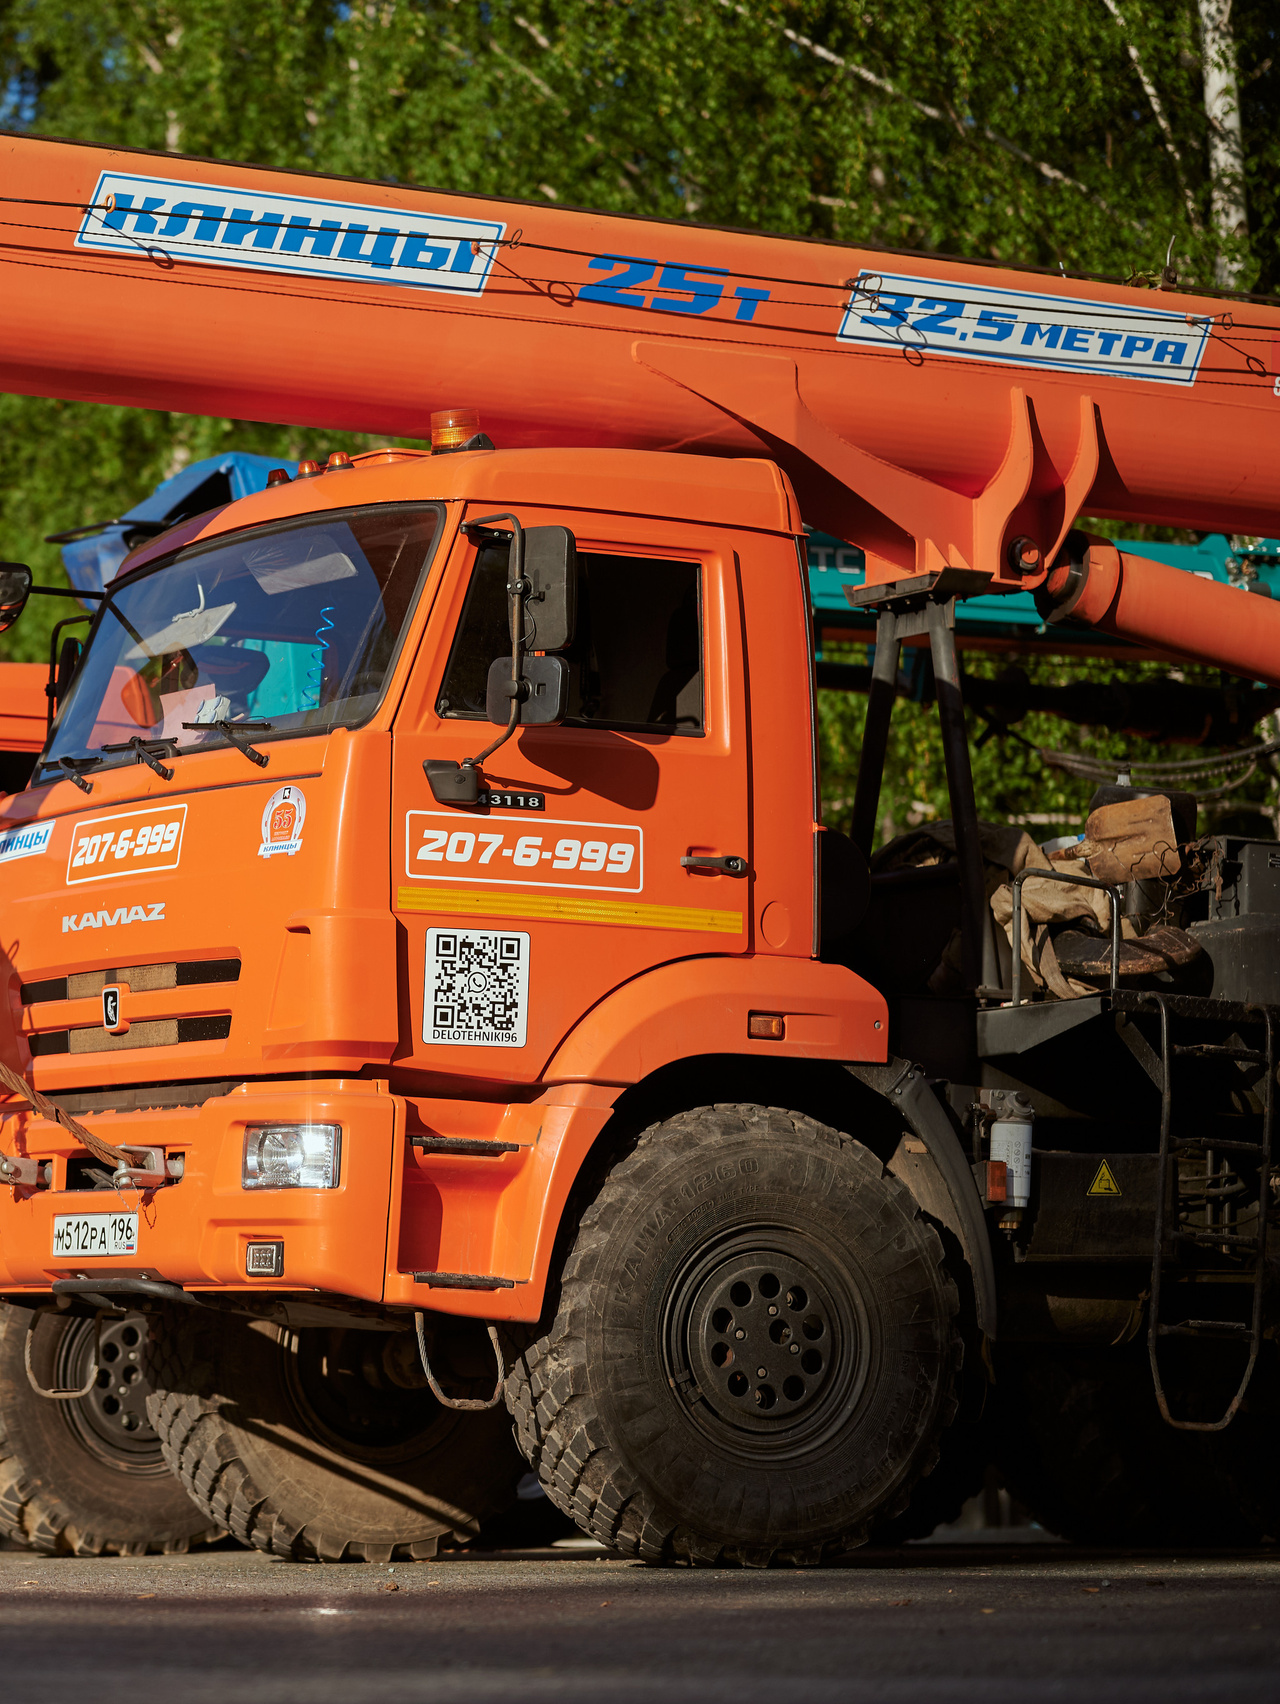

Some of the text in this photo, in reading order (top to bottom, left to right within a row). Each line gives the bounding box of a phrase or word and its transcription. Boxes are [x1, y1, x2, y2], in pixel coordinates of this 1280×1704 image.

[102, 193, 480, 273] КЛИНЦЫ
[1020, 323, 1188, 365] МЕТРА
[273, 808, 293, 829] 55
[72, 822, 180, 867] 207-6-999
[263, 843, 297, 852] КЛИНЦЫ
[417, 830, 635, 873] 207-6-999
[62, 903, 165, 932] KAMAZ
[432, 1030, 517, 1042] DELOTEHNIKI96
[56, 1217, 135, 1250] М512РА 196
[114, 1241, 126, 1250] RUS
